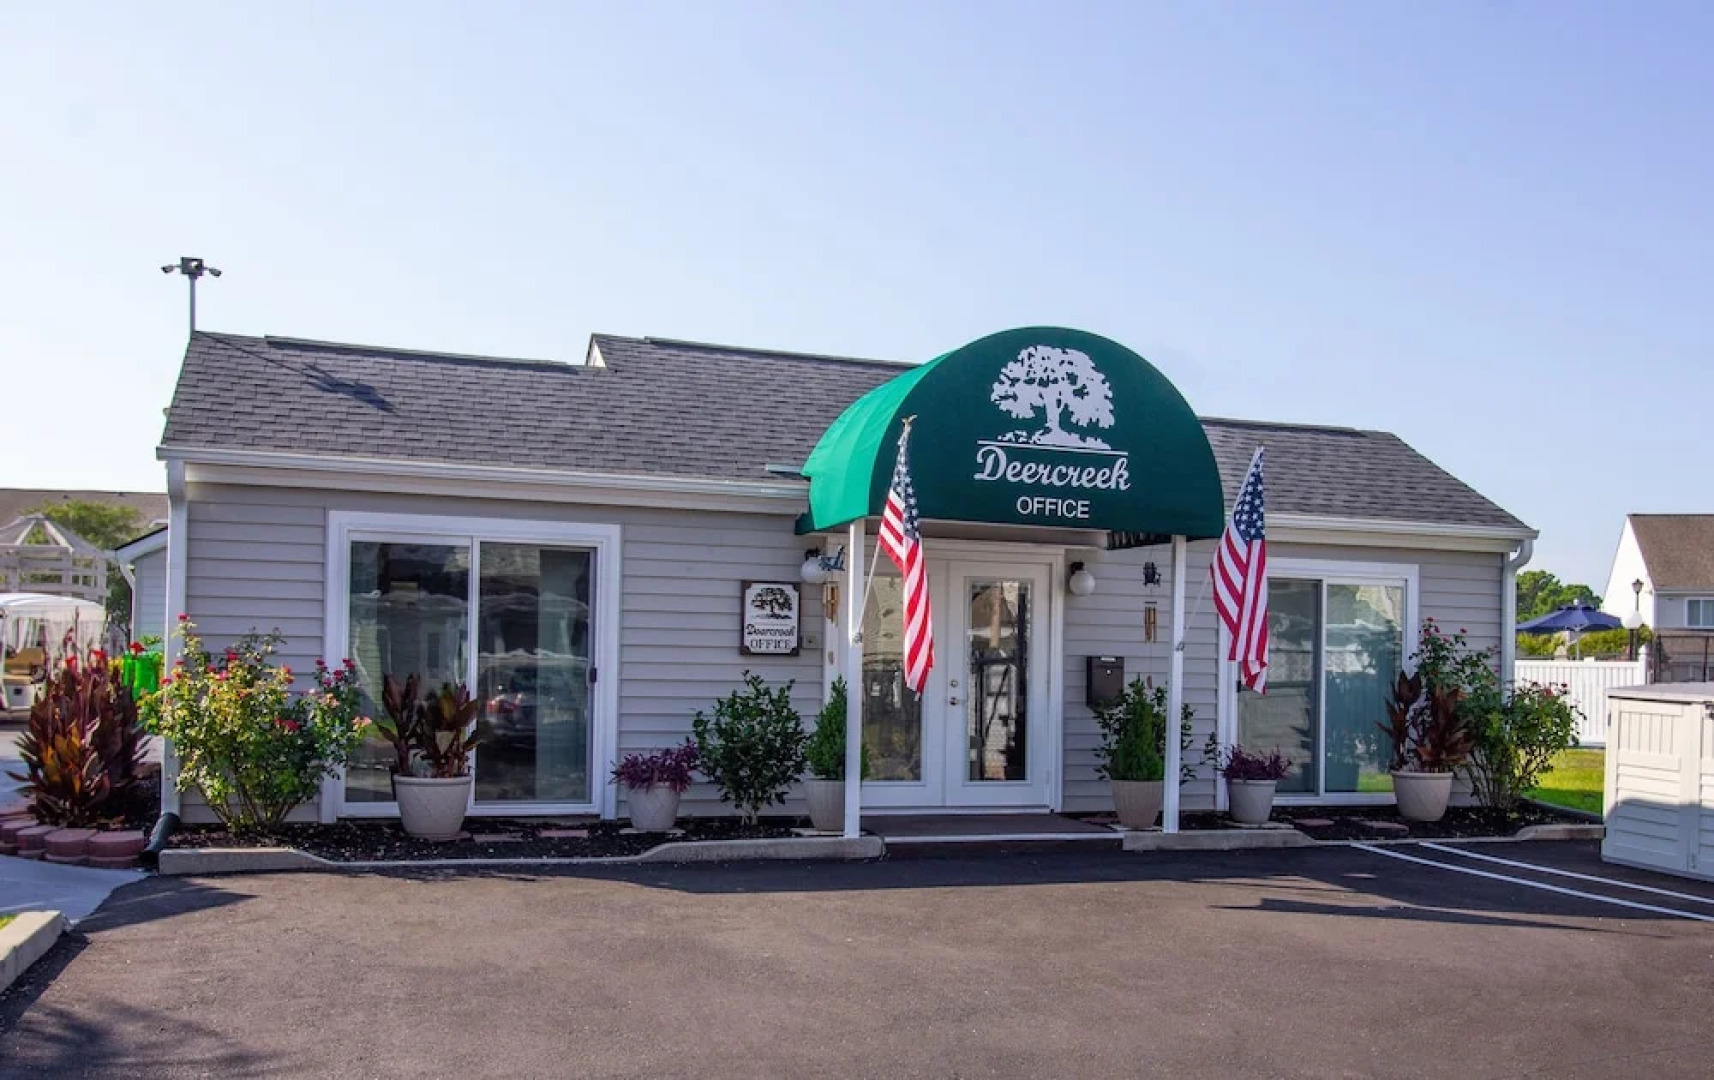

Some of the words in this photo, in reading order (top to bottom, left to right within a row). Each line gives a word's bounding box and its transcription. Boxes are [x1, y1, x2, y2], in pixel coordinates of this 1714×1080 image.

[973, 445, 1131, 491] Deercreek
[1016, 496, 1090, 519] OFFICE
[750, 639, 791, 649] OFFICE
